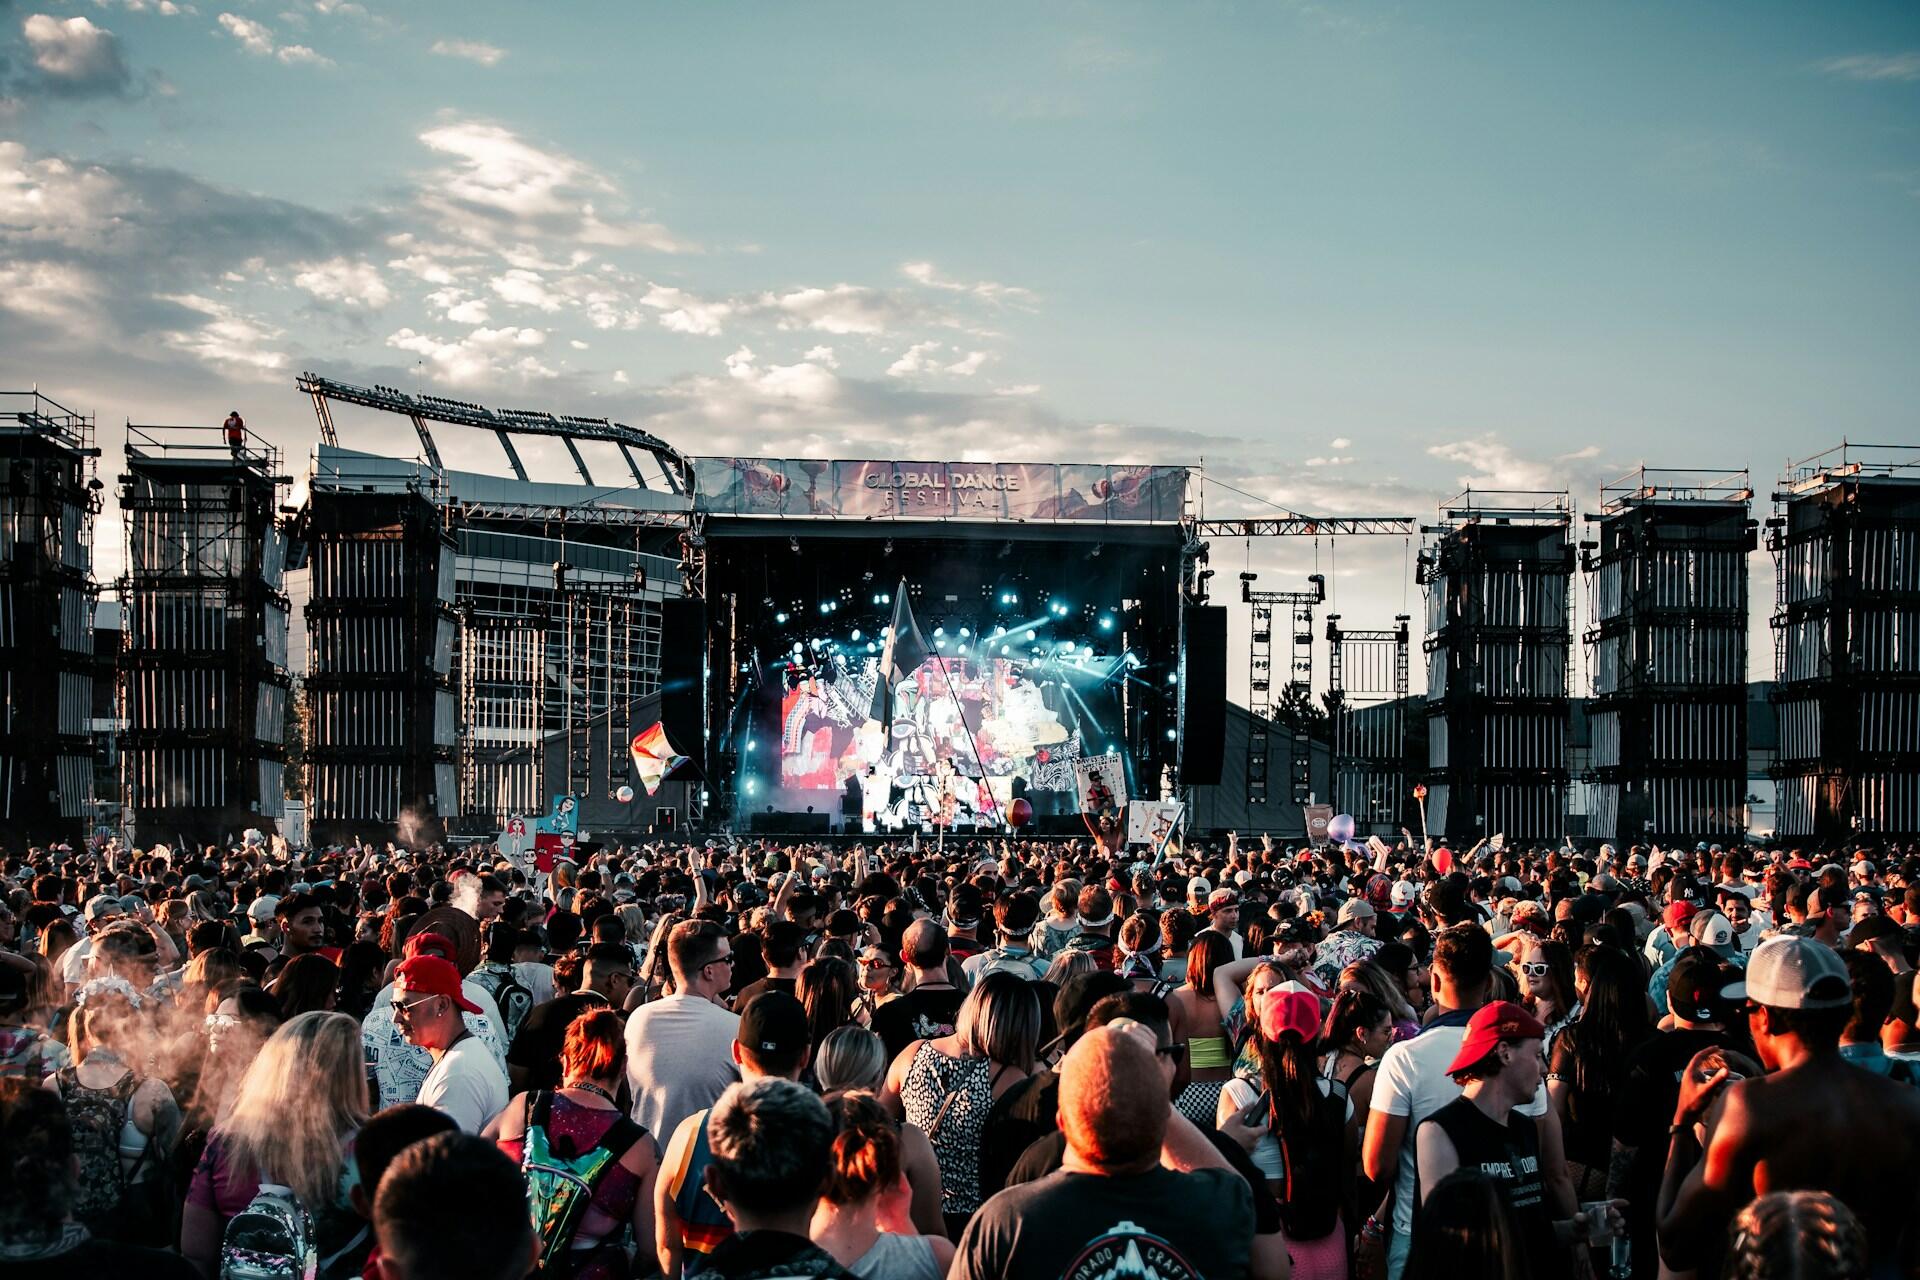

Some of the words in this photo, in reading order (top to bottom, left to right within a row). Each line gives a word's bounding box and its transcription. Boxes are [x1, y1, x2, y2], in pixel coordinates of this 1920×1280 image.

[864, 472, 946, 490] GLOBAL
[951, 472, 1020, 491] DANCE
[885, 490, 999, 507] FESTIVAL
